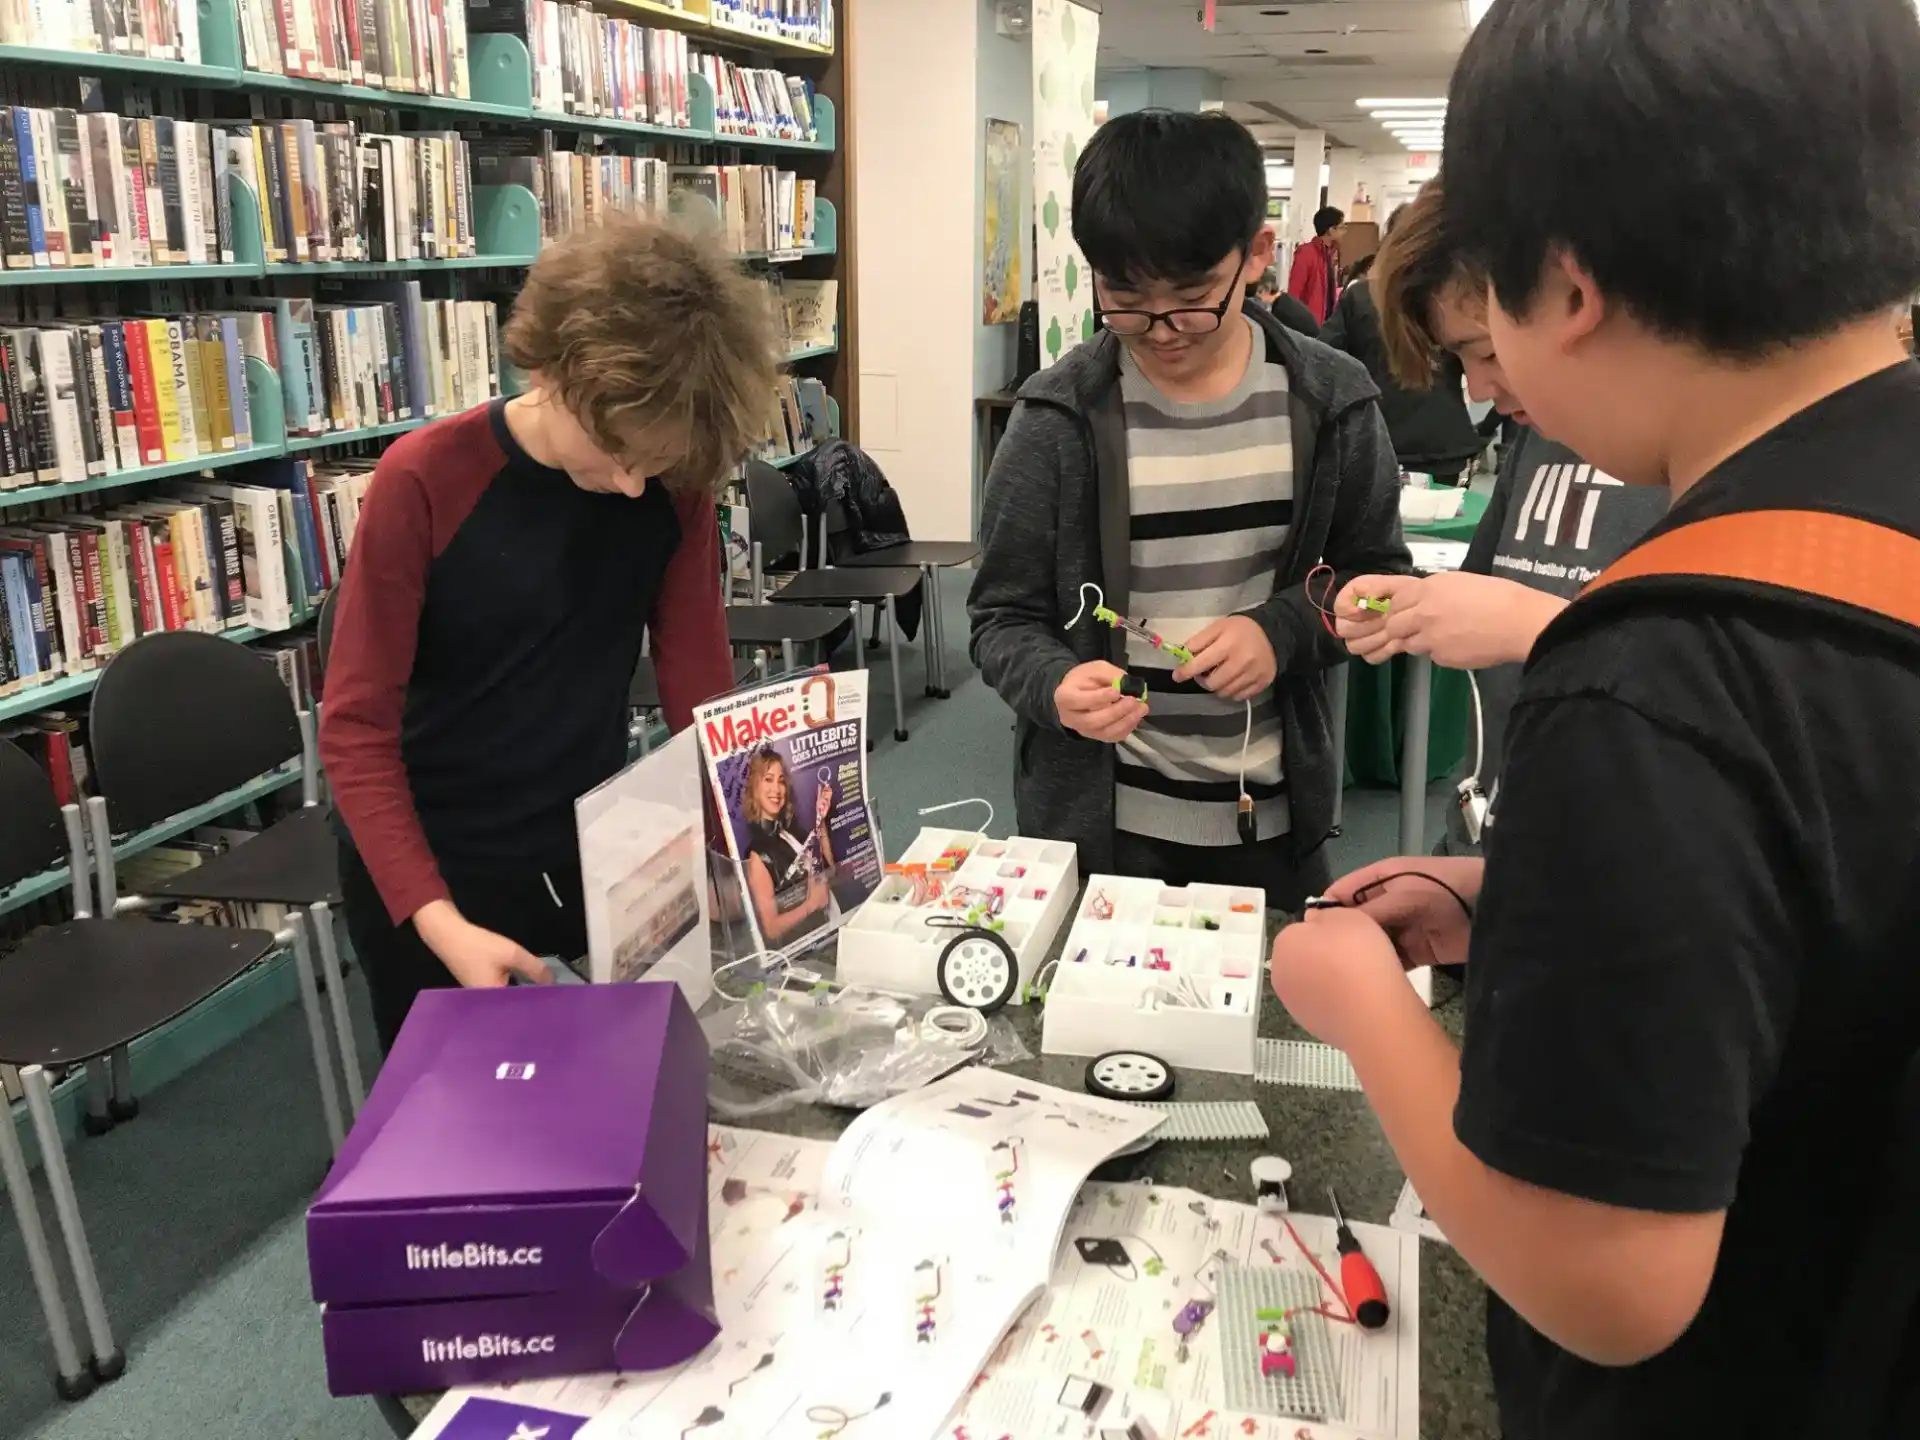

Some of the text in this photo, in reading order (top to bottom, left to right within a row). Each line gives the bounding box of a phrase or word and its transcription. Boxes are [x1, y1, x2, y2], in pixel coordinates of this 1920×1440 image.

[111, 328, 129, 407] BOB WOODWARD
[168, 326, 186, 390] OBAMA
[219, 514, 237, 547] POWER
[267, 504, 279, 547] OBAMA
[70, 538, 81, 567] BLOOD
[88, 550, 99, 565] THE
[224, 548, 240, 575] WARS
[74, 569, 85, 593] FEUD
[1534, 560, 1567, 578] Institute
[1567, 565, 1578, 580] of
[42, 585, 55, 628] ROULETTE
[703, 685, 795, 720] 16 Must-Build Projects
[788, 722, 858, 755] LITTLEBITS
[791, 748, 811, 765] GOES
[812, 746, 820, 757] A
[819, 740, 840, 756] LONG
[840, 734, 858, 748] WAY
[405, 1241, 543, 1270] littleBits.cc
[421, 1334, 556, 1363] littleBits.cc
